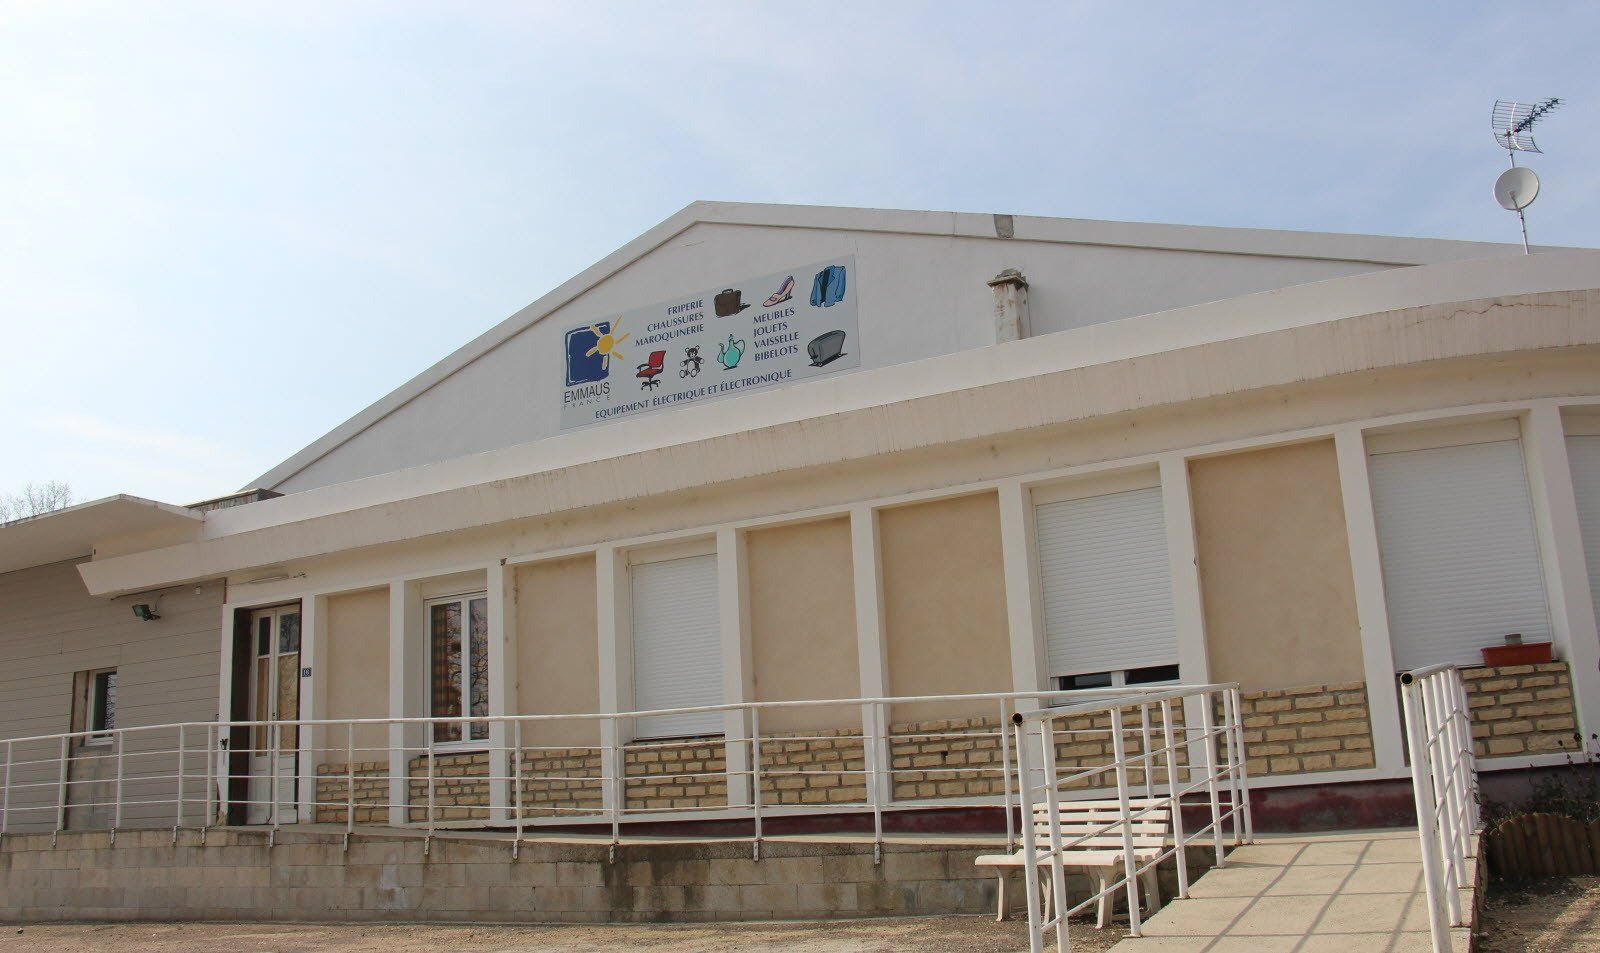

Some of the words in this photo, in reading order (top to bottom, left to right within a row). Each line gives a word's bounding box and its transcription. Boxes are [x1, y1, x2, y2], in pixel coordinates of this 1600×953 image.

[668, 300, 704, 315] FRIPERIE
[753, 307, 795, 324] MEUBLES
[647, 312, 704, 332] CHAUSSURES
[753, 322, 788, 338] JOUETS
[635, 324, 705, 346] MAROQUINERIE
[754, 332, 800, 348] VAISSELLE
[754, 345, 799, 361] BIBELOTS
[564, 382, 611, 403] EMMAUS
[653, 387, 705, 407] ÉLECTRIQUE
[708, 385, 718, 395] ET
[720, 369, 792, 392] ÉLECTRONIQUE
[563, 395, 611, 410] FRANCE
